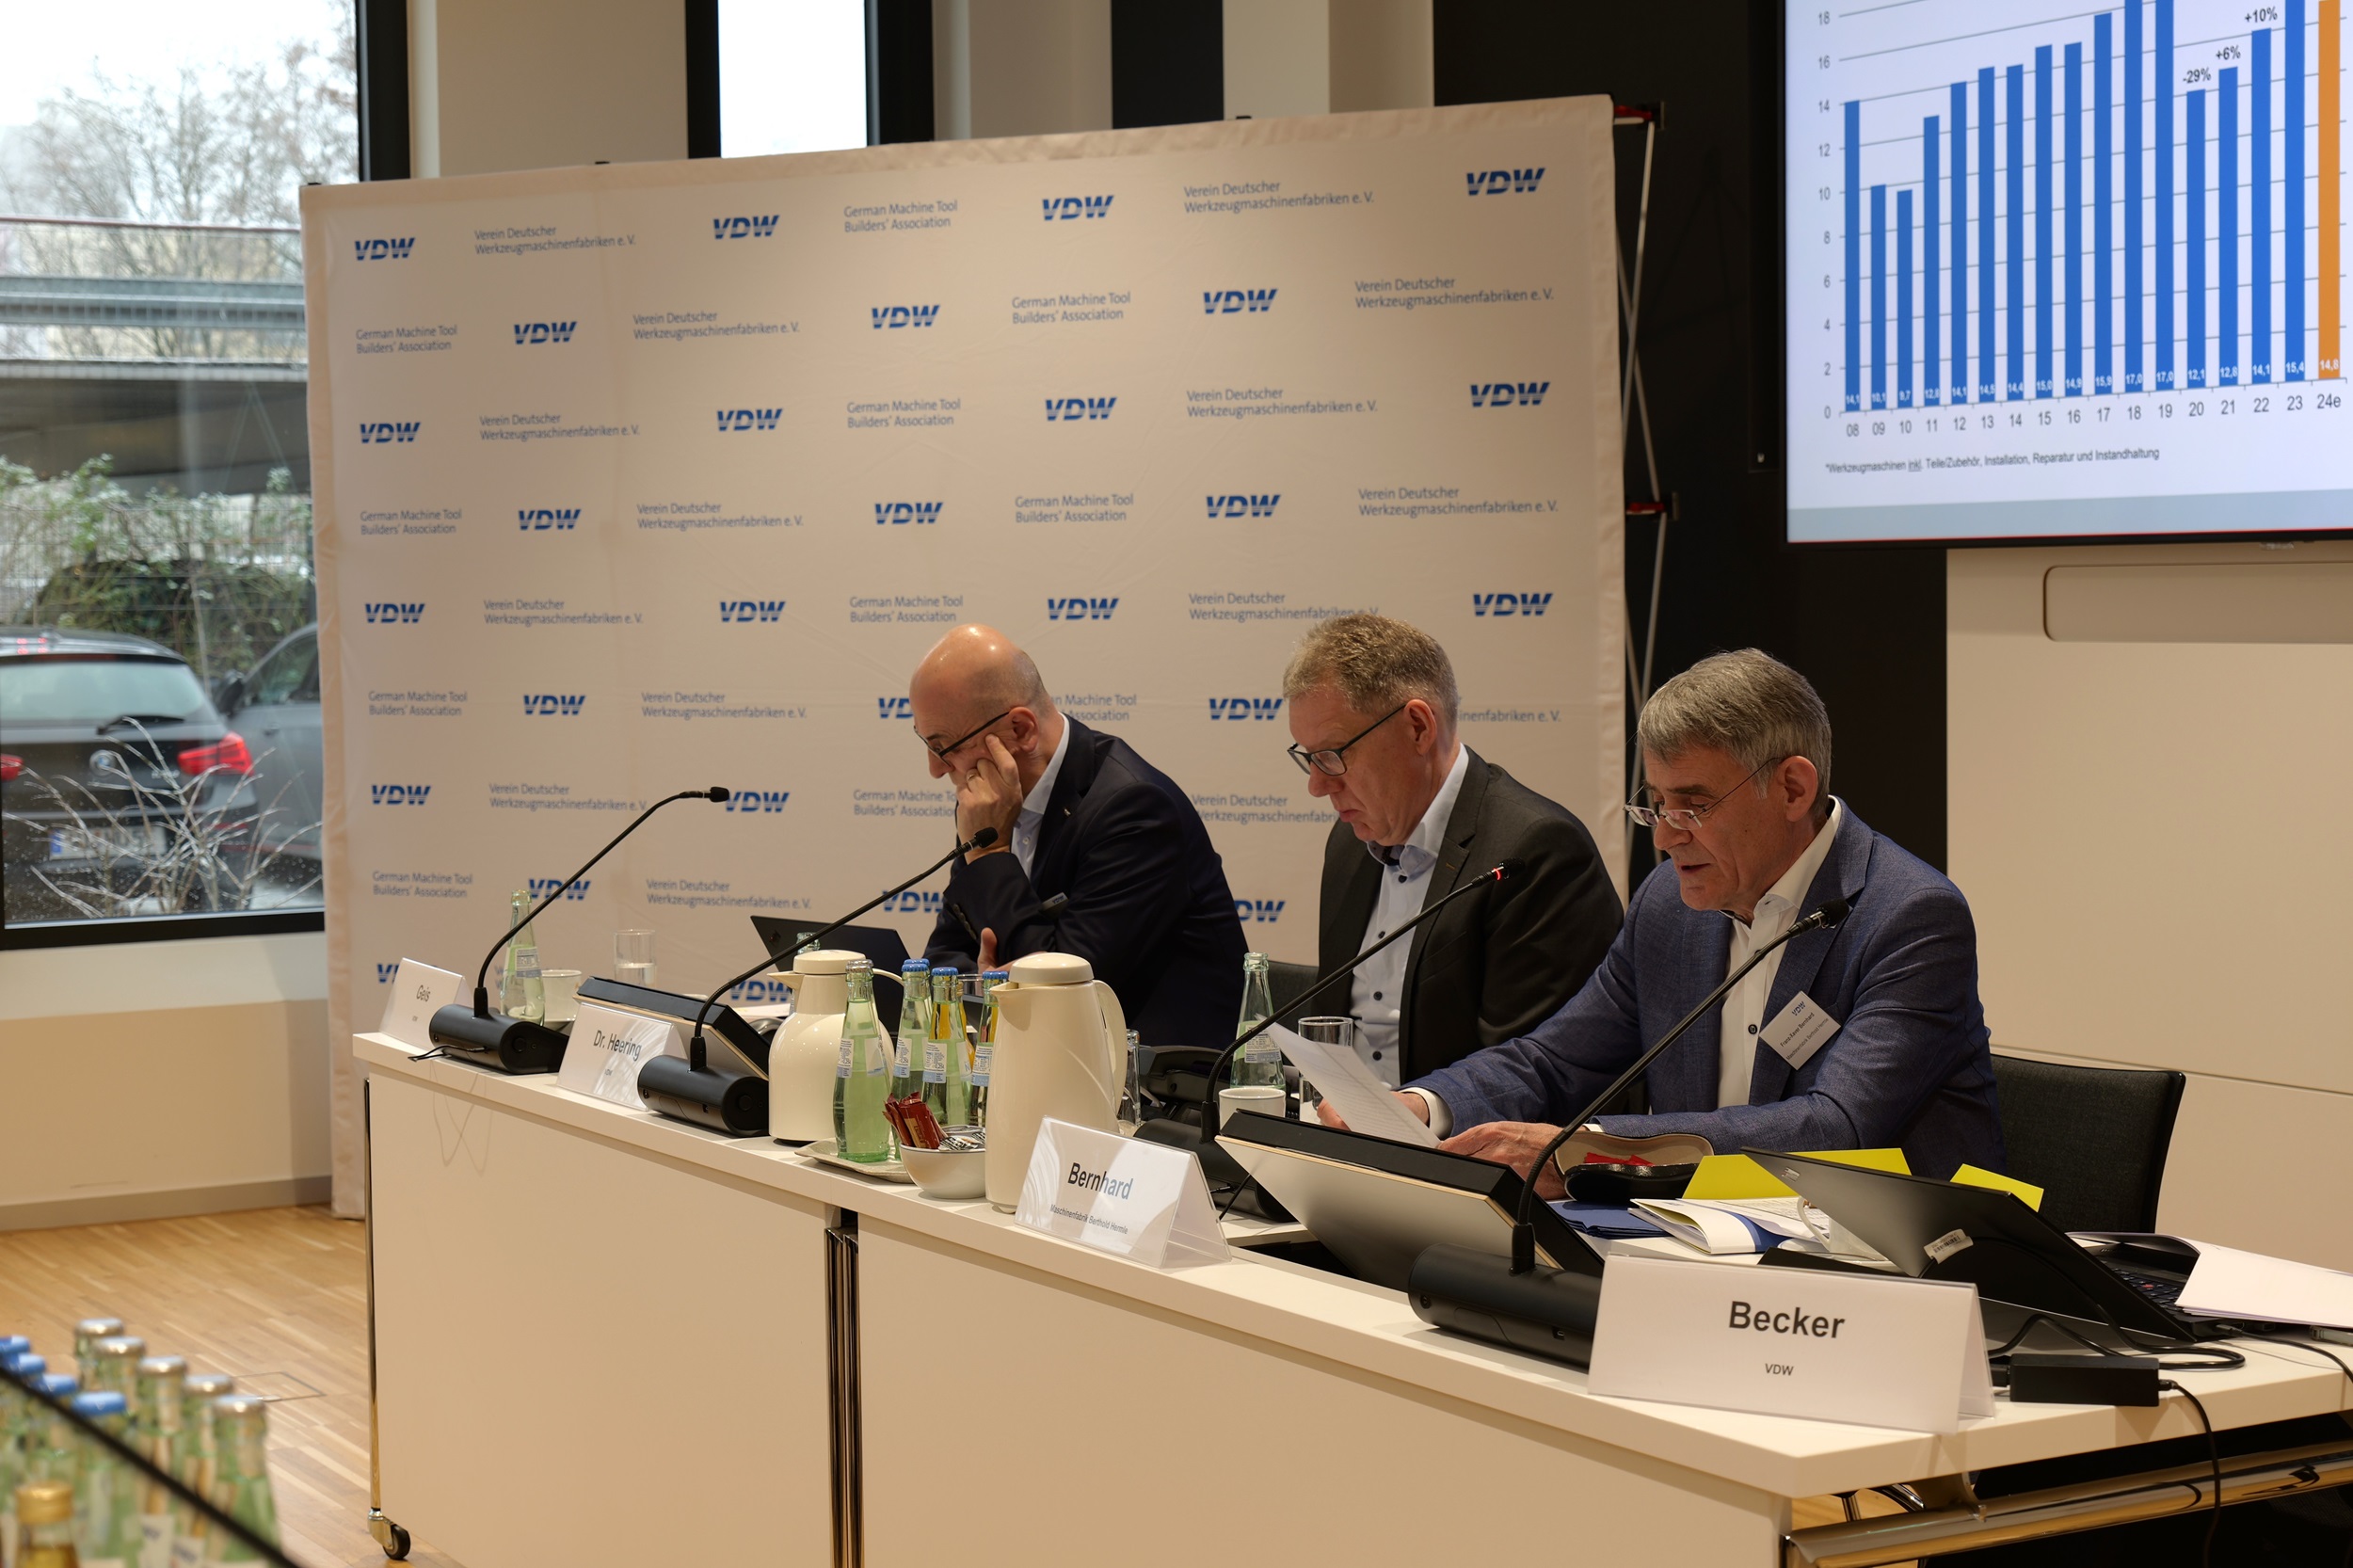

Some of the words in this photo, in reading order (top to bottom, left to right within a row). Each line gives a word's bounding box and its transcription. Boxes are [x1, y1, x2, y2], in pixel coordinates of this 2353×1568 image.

[1818, 11, 1830, 24] 18
[2244, 7, 2278, 23] +10%
[2215, 45, 2241, 60] +6%
[1818, 56, 1830, 69] 16
[2183, 67, 2212, 84] -29%
[1819, 100, 1830, 112] 14
[1819, 143, 1830, 156] 12
[1184, 186, 1219, 198] Verein
[1223, 181, 1280, 196] Deutscher
[1466, 168, 1545, 196] VDW
[1819, 187, 1831, 200] 10
[1042, 195, 1114, 221] VDW
[1184, 193, 1349, 215] Werkzeugmaschinenfabriken
[474, 231, 504, 240] Verein
[507, 226, 556, 238] Deutscher
[713, 215, 779, 240] VDW
[475, 236, 616, 256] Werkzeugmaschinenfabriken
[1824, 231, 1831, 244] 8
[355, 237, 415, 261] VDW
[1355, 281, 1391, 293] Verein
[1395, 277, 1454, 291] Deutscher
[1824, 275, 1831, 288] 6
[1012, 297, 1056, 309] German
[1059, 294, 1106, 306] Machine
[1109, 291, 1130, 304] Tool
[1203, 288, 1278, 314] VDW
[1355, 290, 1528, 310] Werkzeugmaschinenfabriken
[872, 304, 940, 329] VDW
[1062, 309, 1124, 322] Association
[514, 321, 577, 344] VDW
[1824, 319, 1830, 331] 4
[1824, 362, 1831, 376] 2
[2188, 369, 2204, 380] 12,1
[2220, 366, 2237, 377] 12,8
[2252, 364, 2270, 376] 14,1
[2286, 361, 2303, 373] 15,4
[2320, 359, 2338, 371] 14,8
[1187, 391, 1223, 402] Verein
[1225, 388, 1283, 400] Deutscher
[1470, 381, 1550, 408] VDW
[847, 402, 889, 413] German
[892, 400, 937, 411] Machine
[939, 398, 960, 410] Tool
[1045, 396, 1117, 422] VDW
[1187, 401, 1353, 420] Werkzeugmaschinenfabriken
[1824, 406, 1831, 419] 0
[717, 408, 783, 432] VDW
[894, 415, 953, 426] Association
[1847, 424, 1859, 437] 08
[1872, 422, 1885, 436] 09
[1899, 420, 1912, 434] 10
[1927, 419, 1937, 432] 11
[1954, 417, 1966, 430] 12
[1981, 415, 1993, 428] 13
[2010, 414, 2022, 426] 14
[2039, 411, 2051, 425] 15
[2068, 409, 2081, 424] 16
[2097, 408, 2110, 422] 17
[2128, 406, 2141, 420] 18
[2159, 404, 2172, 418] 19
[2189, 402, 2204, 417] 20
[2221, 400, 2234, 415] 21
[2254, 397, 2269, 413] 22
[2287, 395, 2303, 410] 23
[2317, 393, 2341, 408] 24e
[360, 422, 421, 443] VDW
[2033, 453, 2074, 465] Reparatur
[2077, 451, 2093, 461] und
[2095, 448, 2159, 460] Instandhaltung
[1015, 496, 1059, 507] German
[1062, 495, 1109, 506] Machine
[1112, 493, 1133, 505] Tool
[1358, 488, 1395, 500] Verein
[1399, 487, 1459, 499] Deutscher
[360, 511, 398, 521] German
[400, 510, 440, 520] Machine
[442, 509, 461, 520] Tool
[874, 502, 943, 525] VDW
[1064, 510, 1127, 521] Association
[1206, 494, 1281, 519] VDW
[1359, 501, 1532, 519] Werkzeugmaschinenfabriken
[519, 508, 582, 531] VDW
[403, 524, 456, 534] Association
[850, 597, 891, 608] German
[894, 597, 940, 607] Machine
[942, 596, 963, 607] Tool
[1048, 598, 1119, 620] VDW
[1473, 593, 1553, 616] VDW
[365, 603, 425, 623] VDW
[720, 600, 786, 623] VDW
[897, 612, 956, 622] Association
[523, 695, 586, 715] VDW
[642, 693, 672, 702] Verein
[675, 692, 725, 703] Deutscher
[642, 707, 785, 720] Werkzeugmaschinenfabriken
[1209, 698, 1283, 720] VDW
[372, 785, 431, 806] VDW
[724, 792, 789, 812] VDW
[529, 879, 590, 901] VDW
[1235, 900, 1285, 922] DW
[416, 984, 431, 1002] Geis
[730, 982, 792, 1001] VDW
[1791, 1000, 1806, 1016] VDW
[593, 1030, 605, 1048] Dr.
[607, 1032, 642, 1062] Heering
[1067, 1162, 1133, 1199] Bernhard
[1049, 1204, 1088, 1224] Maschinenfabrik
[1088, 1215, 1111, 1230] Berthold
[1110, 1223, 1128, 1235] Hermle
[1728, 1301, 1846, 1339] Becker
[1765, 1363, 1794, 1377] VDW
